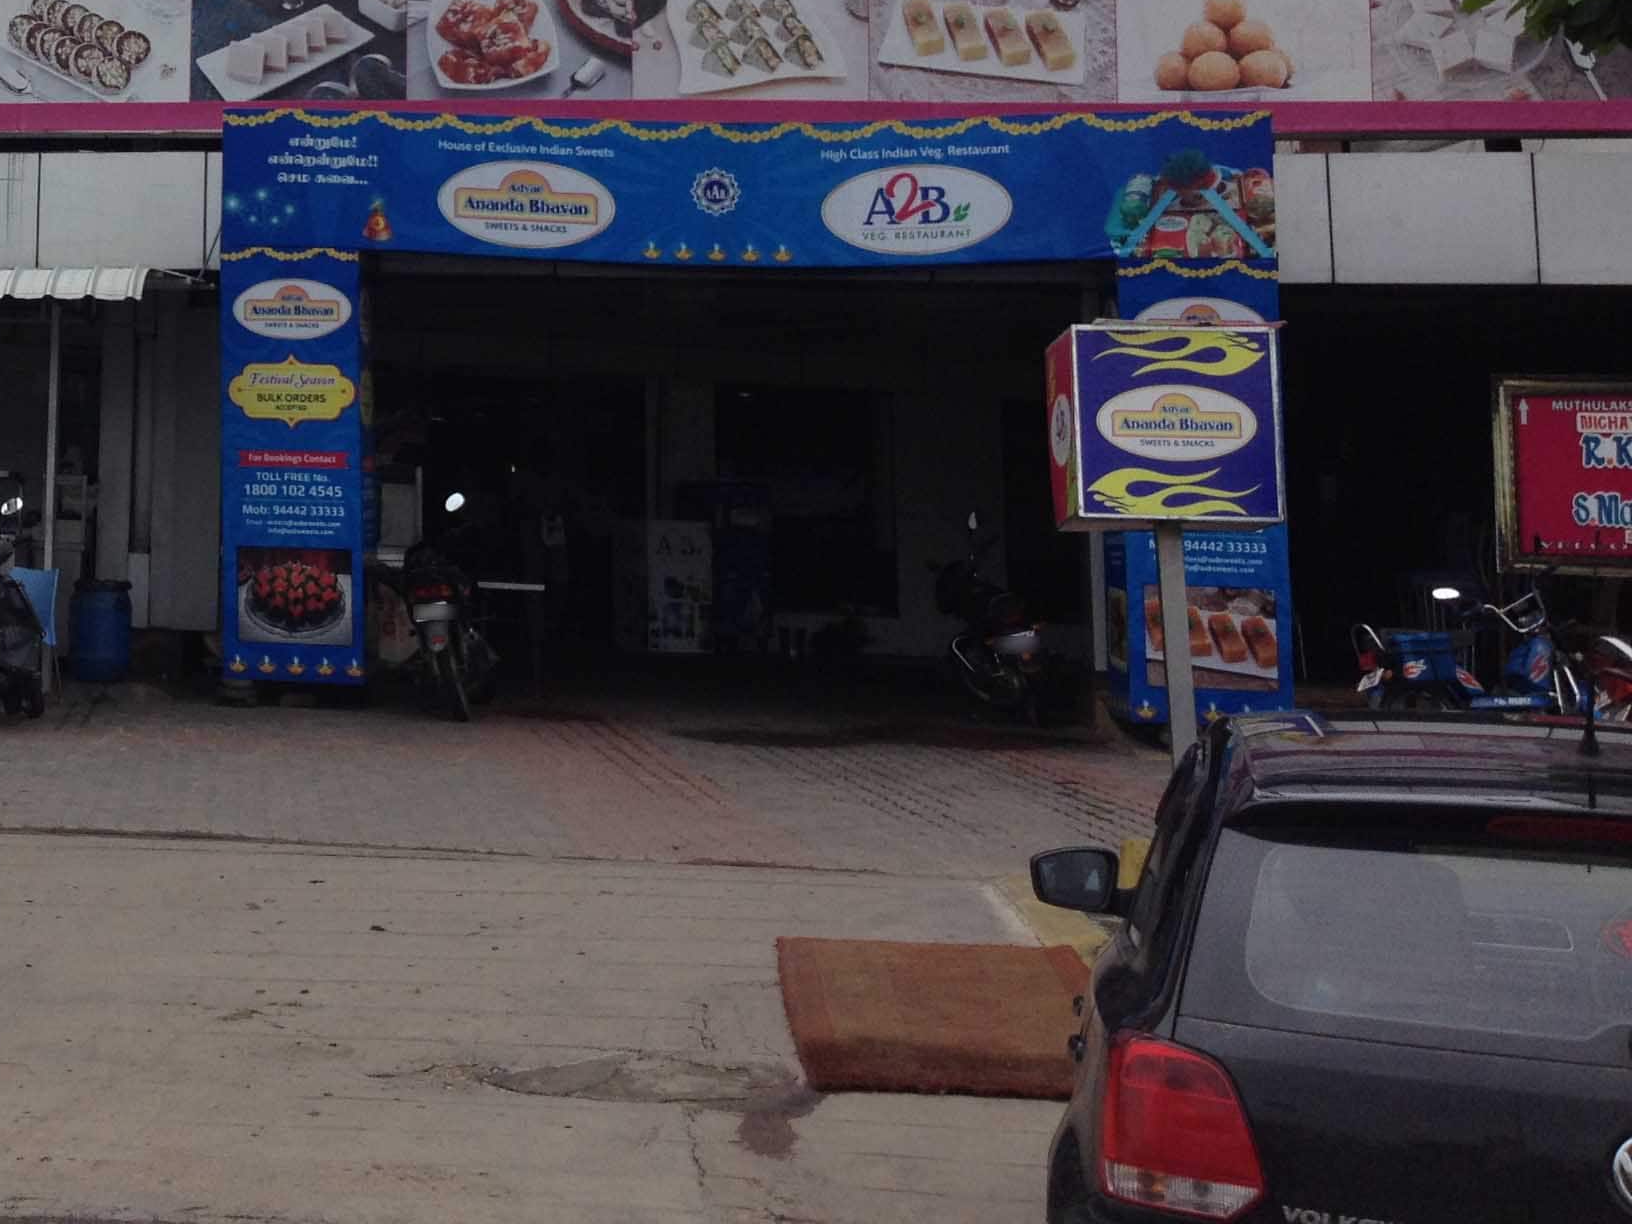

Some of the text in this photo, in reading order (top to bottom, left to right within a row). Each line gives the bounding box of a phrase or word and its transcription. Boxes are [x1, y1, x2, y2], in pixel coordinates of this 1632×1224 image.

[438, 139, 615, 159] House of Exclusive Indian Sweets
[820, 143, 1010, 163] High Class Indian Veg. Restaurant
[464, 195, 589, 216] Ananda Bhavan
[863, 173, 950, 225] A2B
[484, 222, 520, 232] SWEETS
[531, 223, 568, 234] SNACKS
[894, 228, 972, 241] RESTAURANT
[249, 372, 336, 389] Festival Season
[256, 393, 327, 404] BULK ORDERS
[1121, 417, 1234, 432] Ananda Bhavan
[1580, 415, 1632, 431] NICHA
[255, 471, 281, 481] TOLL
[283, 472, 310, 482] FREE
[244, 484, 343, 497] 1800 102 4545
[272, 504, 307, 516] 94442
[310, 505, 344, 517] 33333
[1183, 539, 1267, 554] 94442 33333
